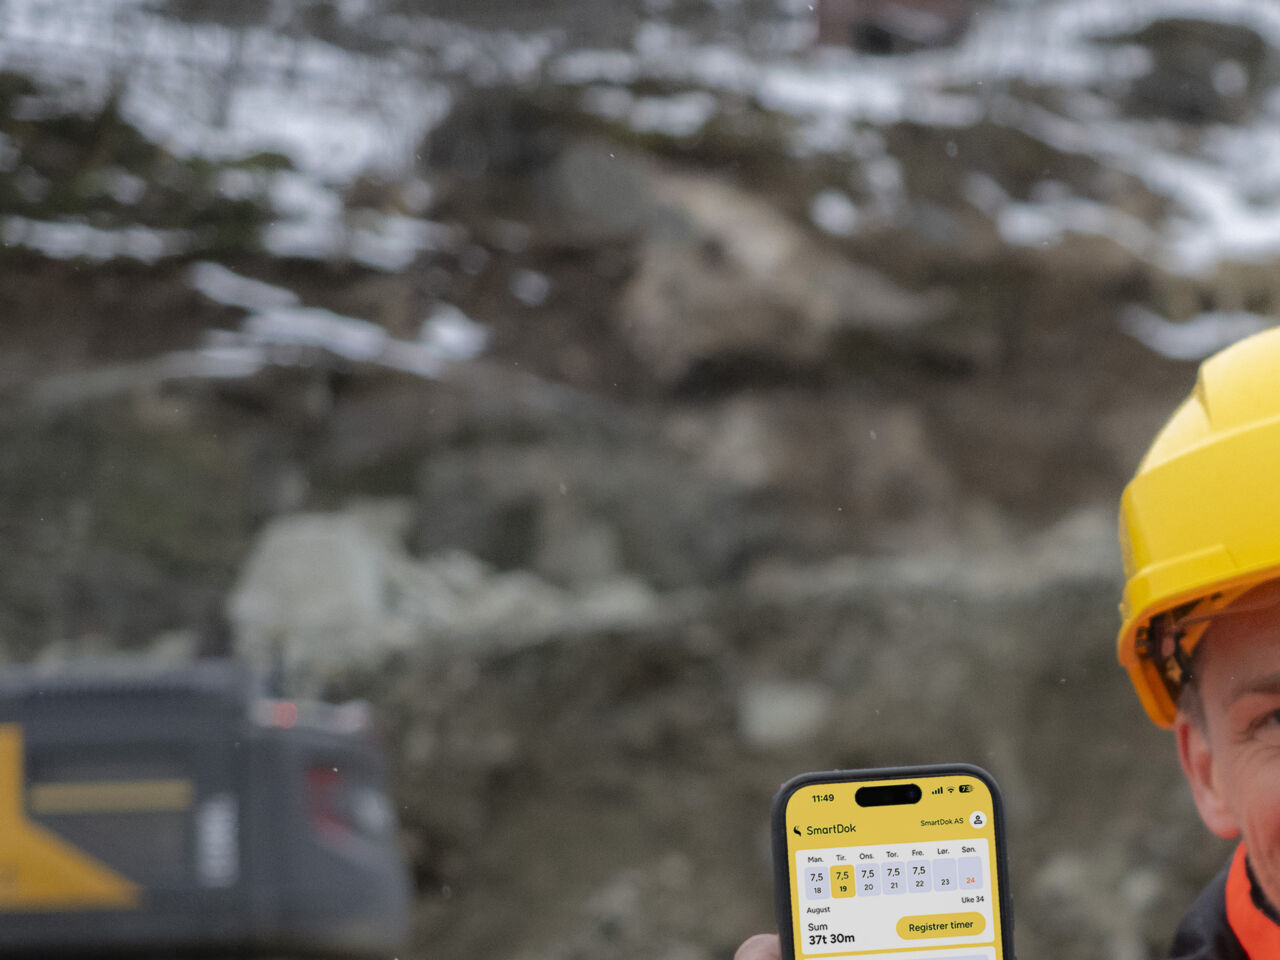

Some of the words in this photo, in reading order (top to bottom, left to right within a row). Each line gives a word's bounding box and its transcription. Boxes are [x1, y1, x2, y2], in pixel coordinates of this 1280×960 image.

[812, 794, 834, 803] 11:49
[920, 819, 953, 827] SmartDok
[806, 824, 856, 835] SmartDok
[810, 873, 824, 882] 7,5
[836, 871, 849, 880] 7,5
[861, 869, 875, 879] 7,5
[887, 868, 900, 877] 7,5
[912, 866, 926, 876] 7,5
[941, 878, 950, 886] 23
[975, 895, 985, 903] 34
[806, 906, 831, 914] August
[808, 923, 828, 931] Sum
[908, 923, 948, 933] Registrer
[950, 920, 974, 929] timer
[809, 935, 827, 945] 37t
[830, 933, 855, 944] 30m
